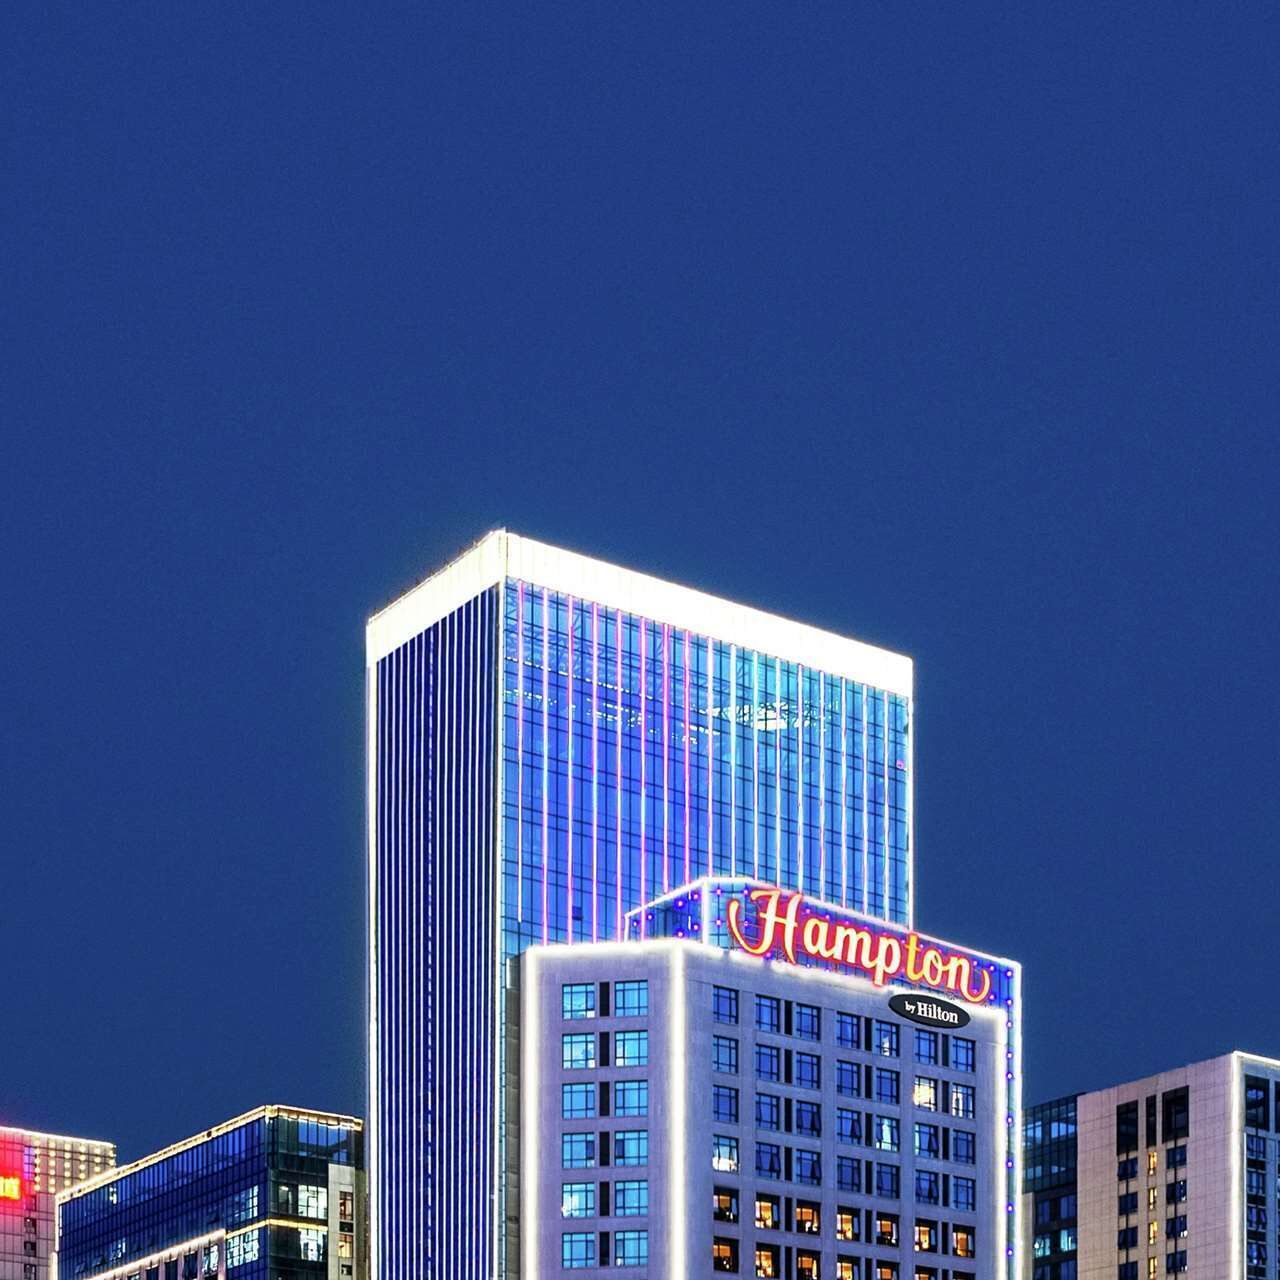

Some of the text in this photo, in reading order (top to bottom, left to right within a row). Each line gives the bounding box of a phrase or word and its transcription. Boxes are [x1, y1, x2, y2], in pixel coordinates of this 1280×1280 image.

[729, 887, 991, 1003] Hampton
[904, 1000, 959, 1024] by Hilton
